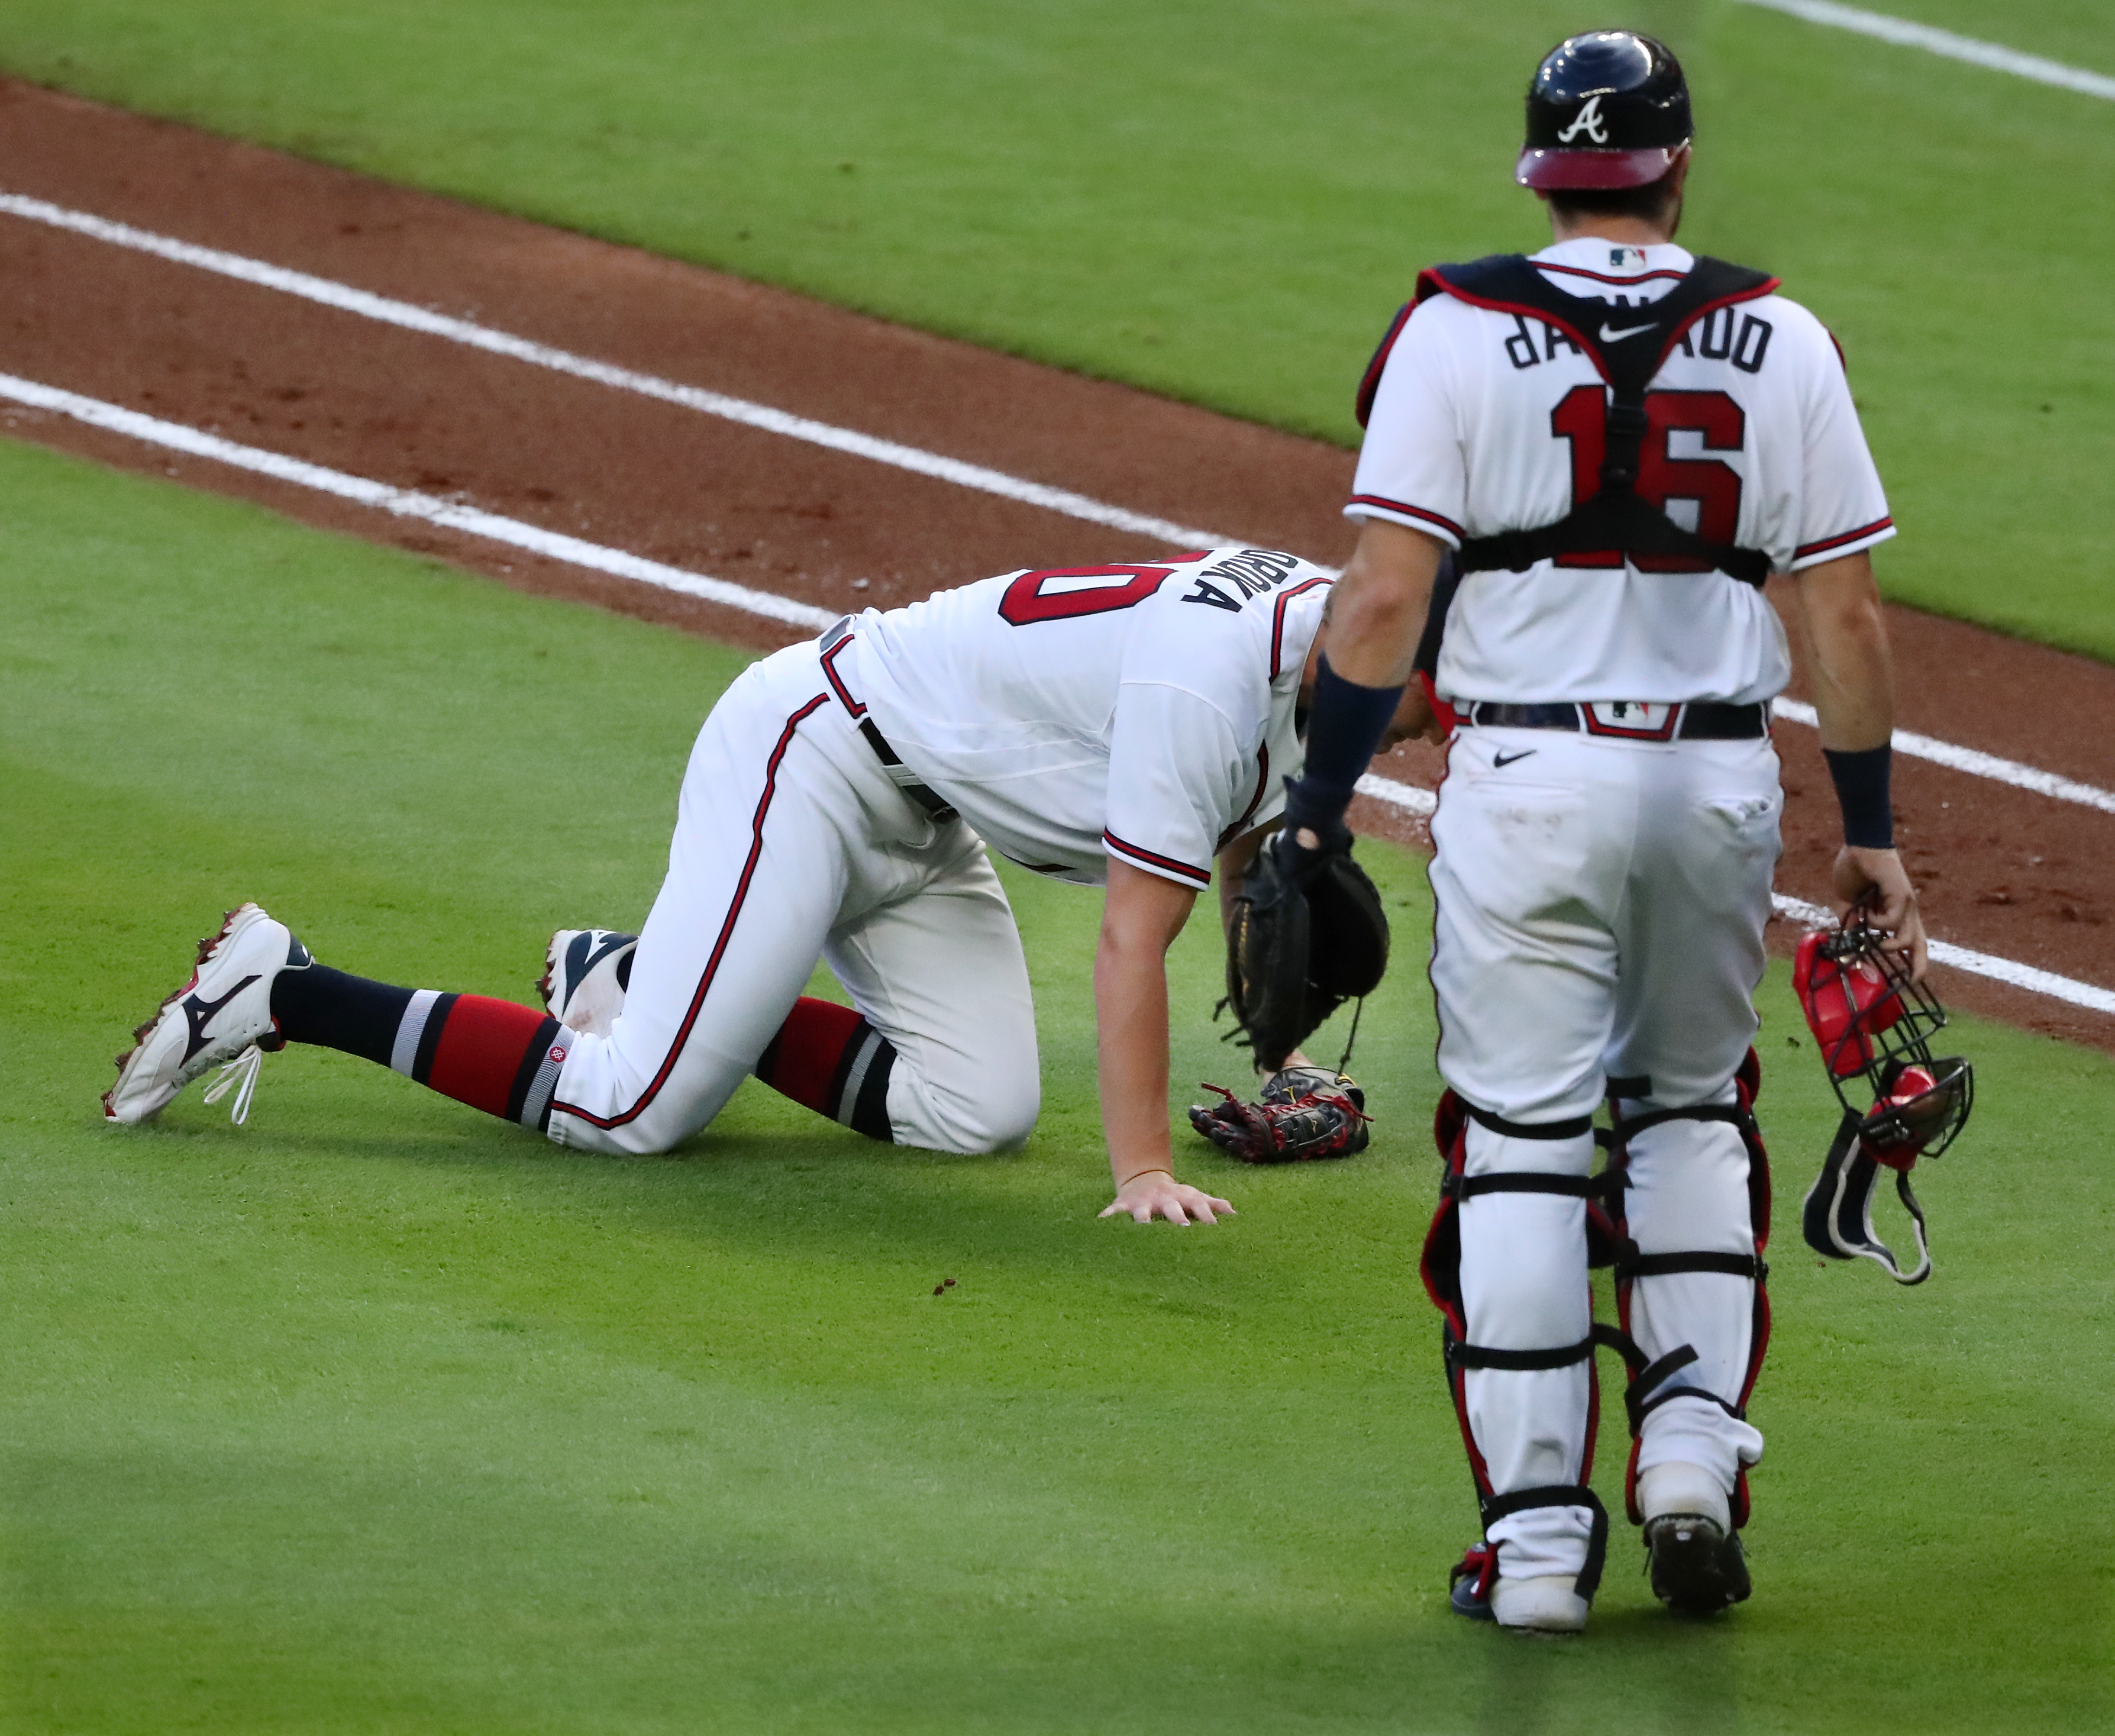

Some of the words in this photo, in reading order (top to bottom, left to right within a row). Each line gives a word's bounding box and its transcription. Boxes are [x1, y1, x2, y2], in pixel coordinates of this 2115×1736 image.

[1558, 95, 1608, 143] A
[1504, 295, 1773, 374] dAUD
[1551, 385, 1746, 573] 16
[997, 550, 1216, 627] 0
[1180, 550, 1299, 612] OROKA
